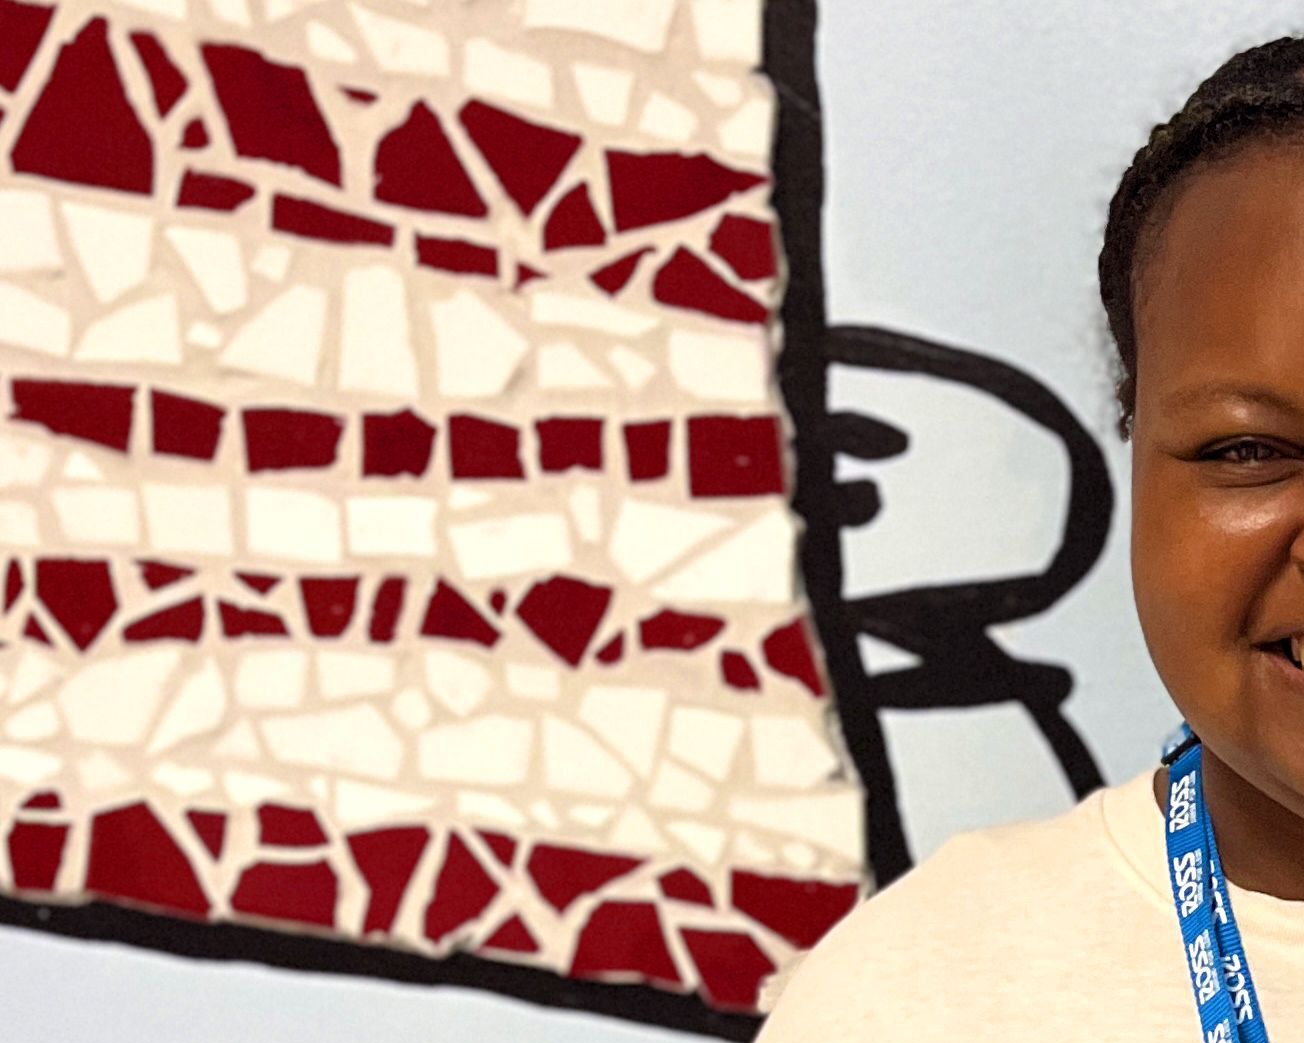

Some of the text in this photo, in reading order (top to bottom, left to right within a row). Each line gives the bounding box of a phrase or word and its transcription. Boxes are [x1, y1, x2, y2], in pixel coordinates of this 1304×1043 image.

[1169, 775, 1190, 833] ROSS
[1173, 851, 1198, 918] ROSS
[1189, 935, 1215, 1005] ROSS
